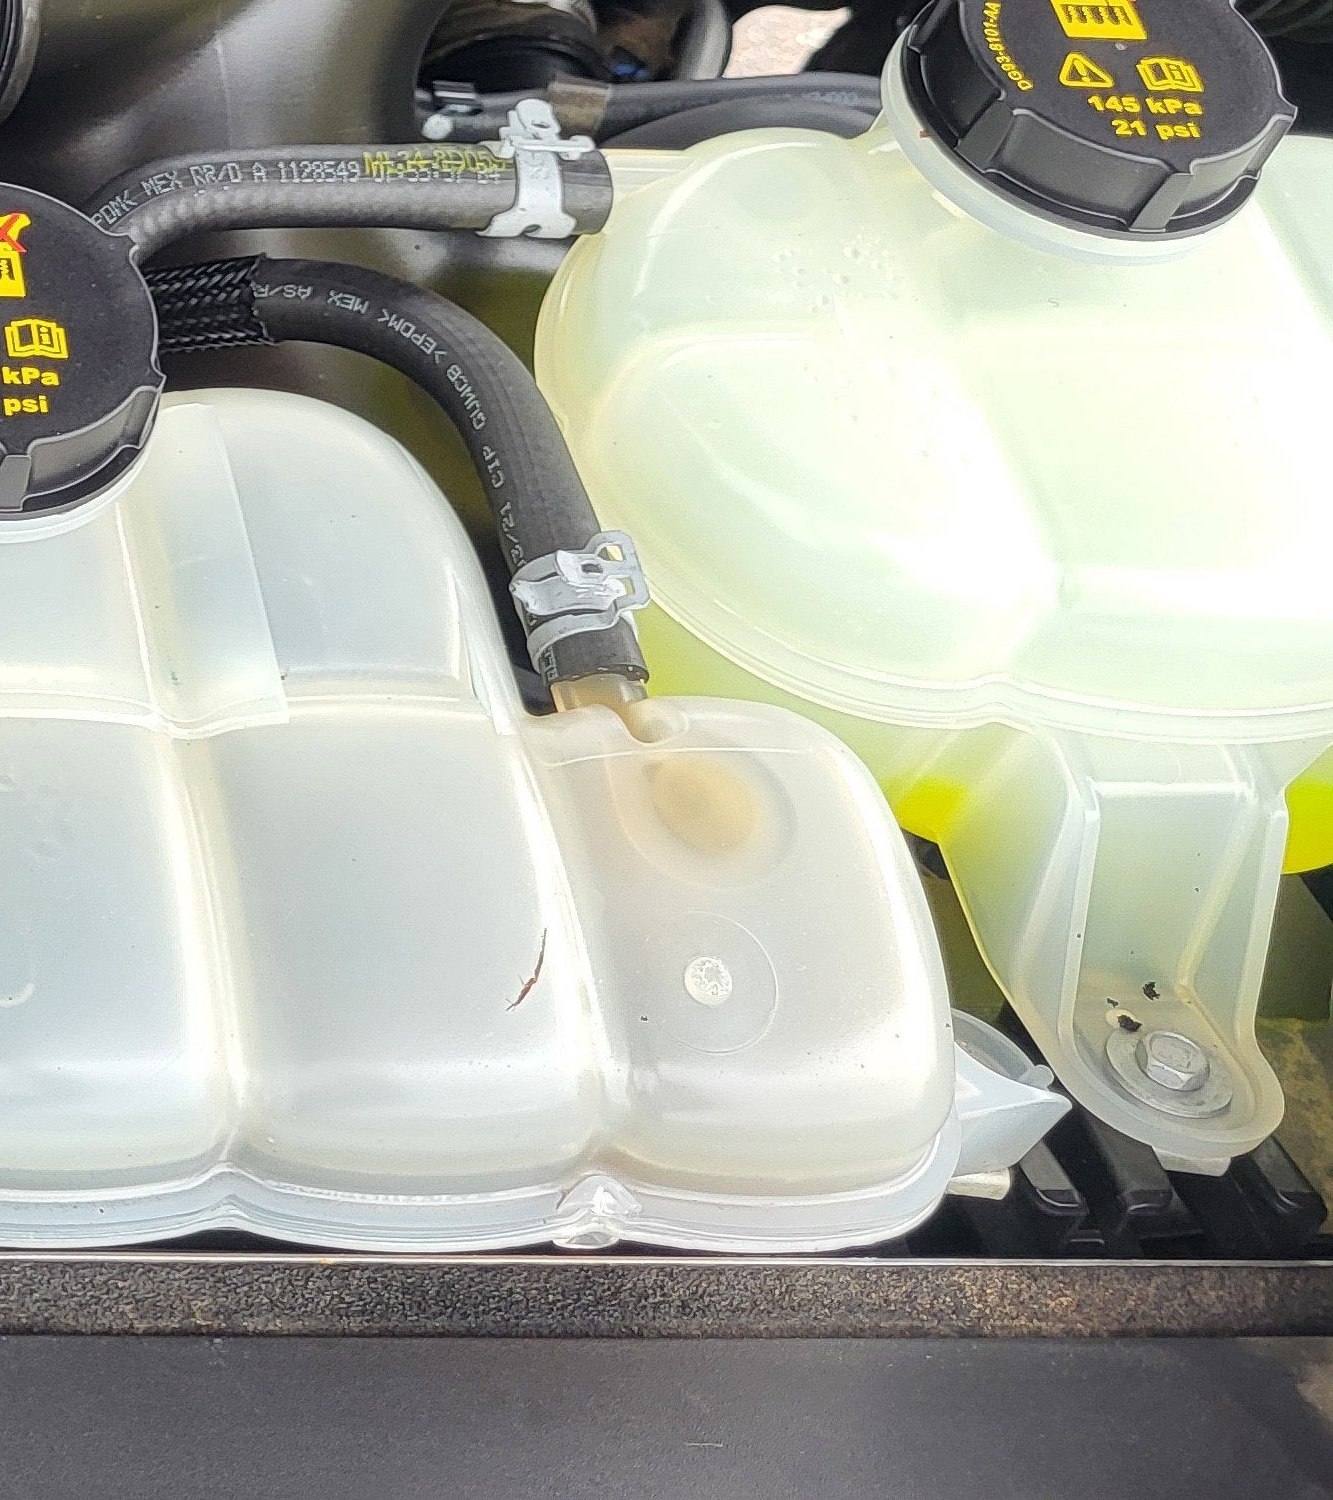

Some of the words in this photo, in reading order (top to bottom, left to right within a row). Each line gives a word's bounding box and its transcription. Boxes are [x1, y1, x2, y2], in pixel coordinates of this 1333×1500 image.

[981, 0, 1034, 92] DG93-8101-AA
[1087, 96, 1140, 112] 145
[1146, 97, 1203, 116] kPa
[1112, 119, 1147, 137] 21
[1156, 122, 1201, 141] psi
[141, 170, 184, 198] MEX
[252, 162, 269, 184] A
[328, 288, 370, 315] MEX
[2, 364, 60, 387] kPa
[3, 393, 49, 417] psi
[482, 445, 506, 489] CIP
